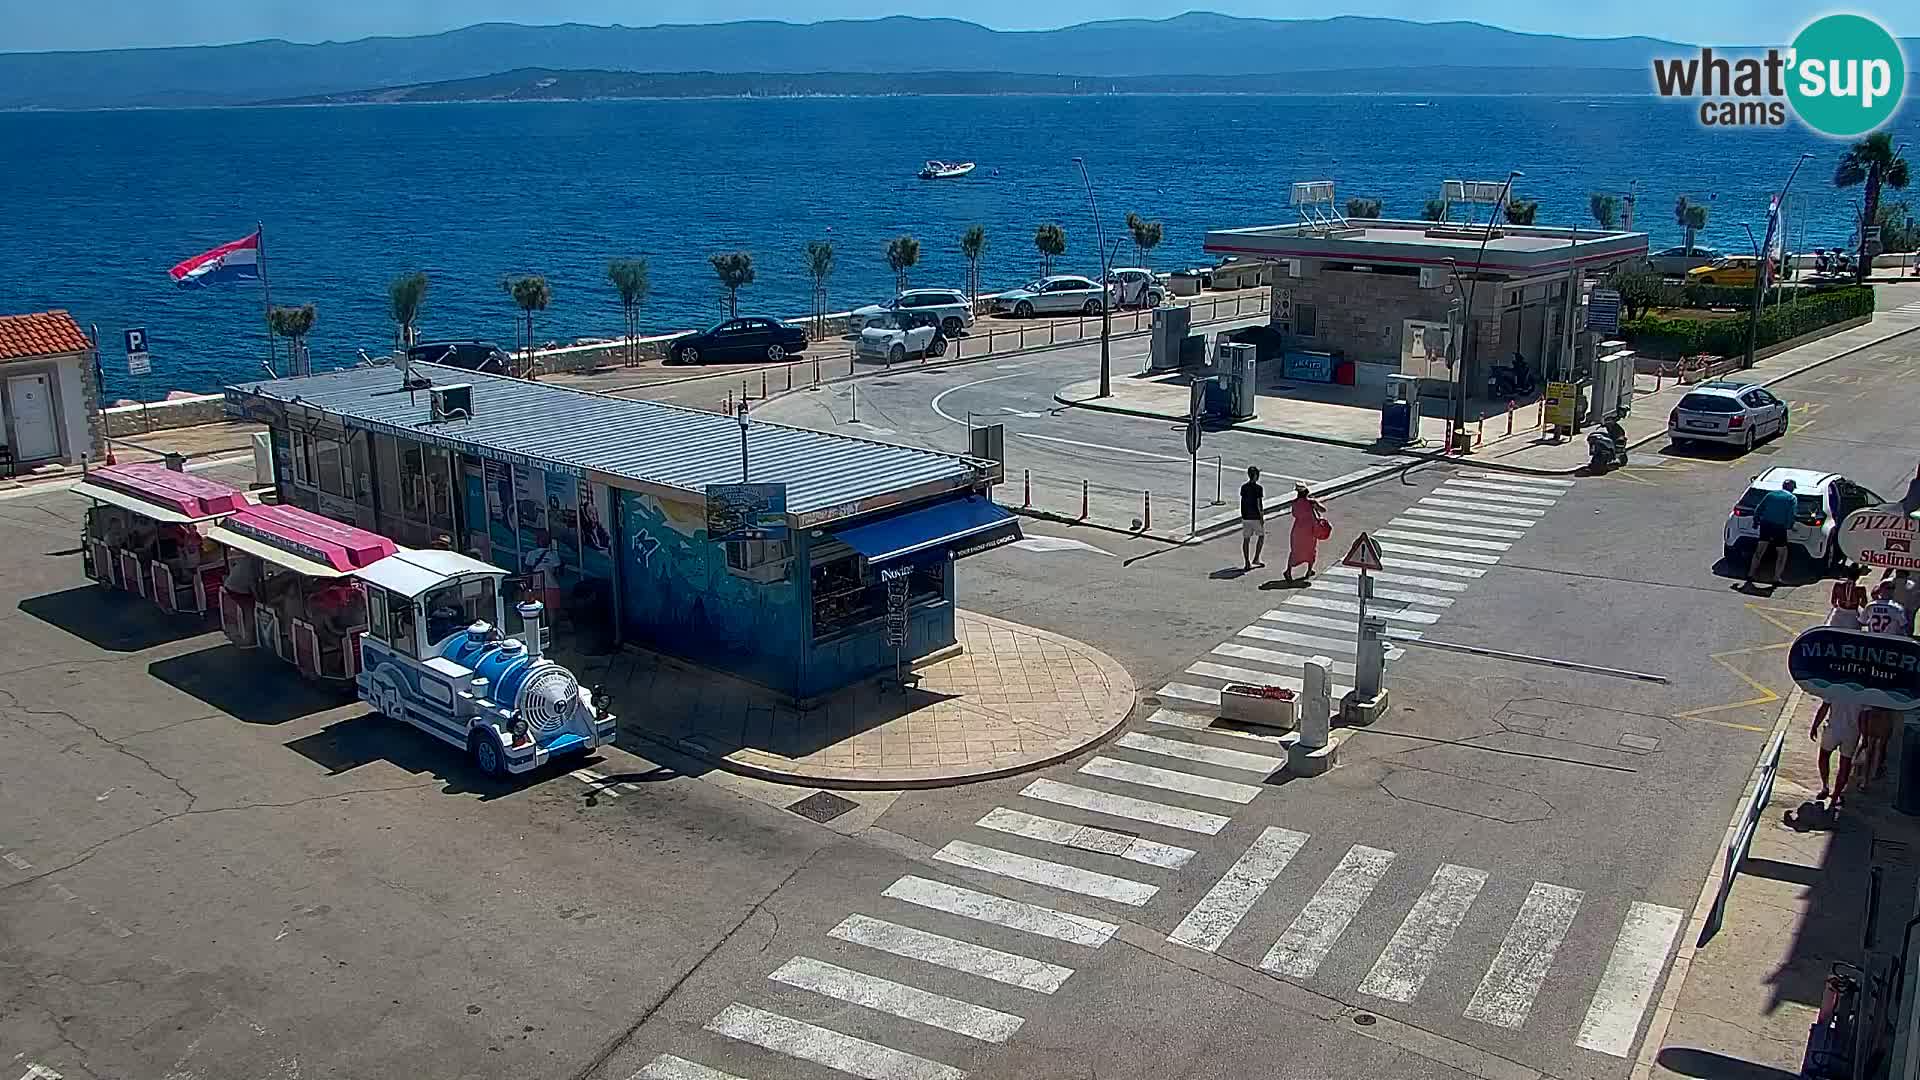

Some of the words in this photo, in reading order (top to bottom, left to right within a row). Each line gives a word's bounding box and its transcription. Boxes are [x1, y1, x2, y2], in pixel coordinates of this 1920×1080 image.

[129, 331, 142, 350] P
[478, 446, 493, 458] BUS
[494, 450, 525, 465] STATION
[528, 457, 553, 472] TICKET
[555, 463, 583, 478] OFFICE
[1849, 515, 1920, 533] PIZZE
[1801, 642, 1920, 672] MARINER
